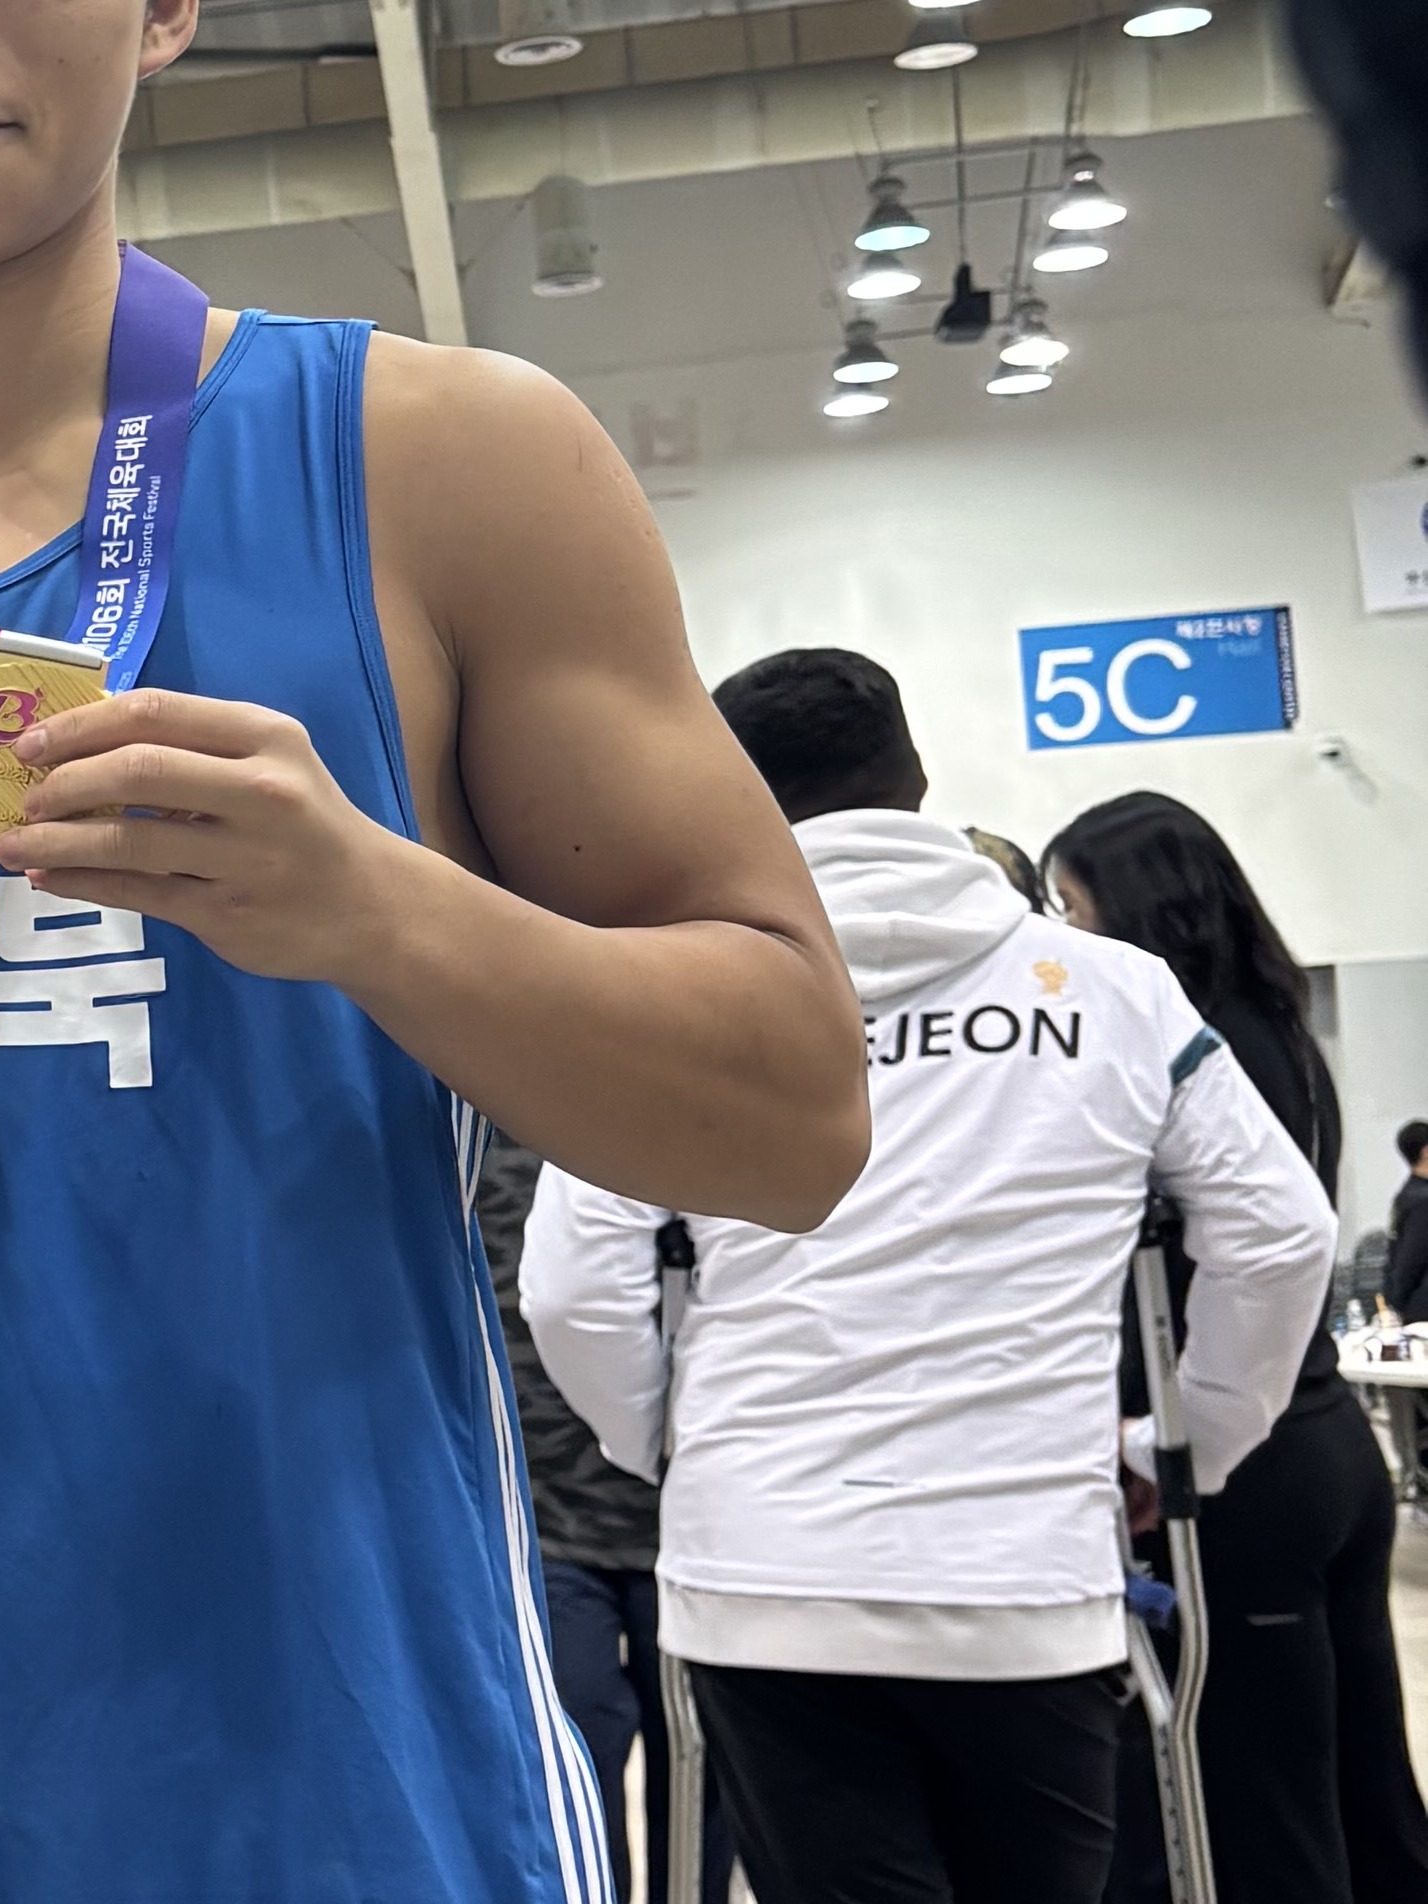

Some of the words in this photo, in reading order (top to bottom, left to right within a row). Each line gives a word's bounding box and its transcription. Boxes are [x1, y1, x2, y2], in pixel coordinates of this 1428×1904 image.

[101, 415, 151, 567] 전국체육대회
[142, 475, 161, 520] Festival
[137, 521, 154, 567] Sports
[129, 569, 149, 618] National
[1034, 637, 1198, 742] 5C
